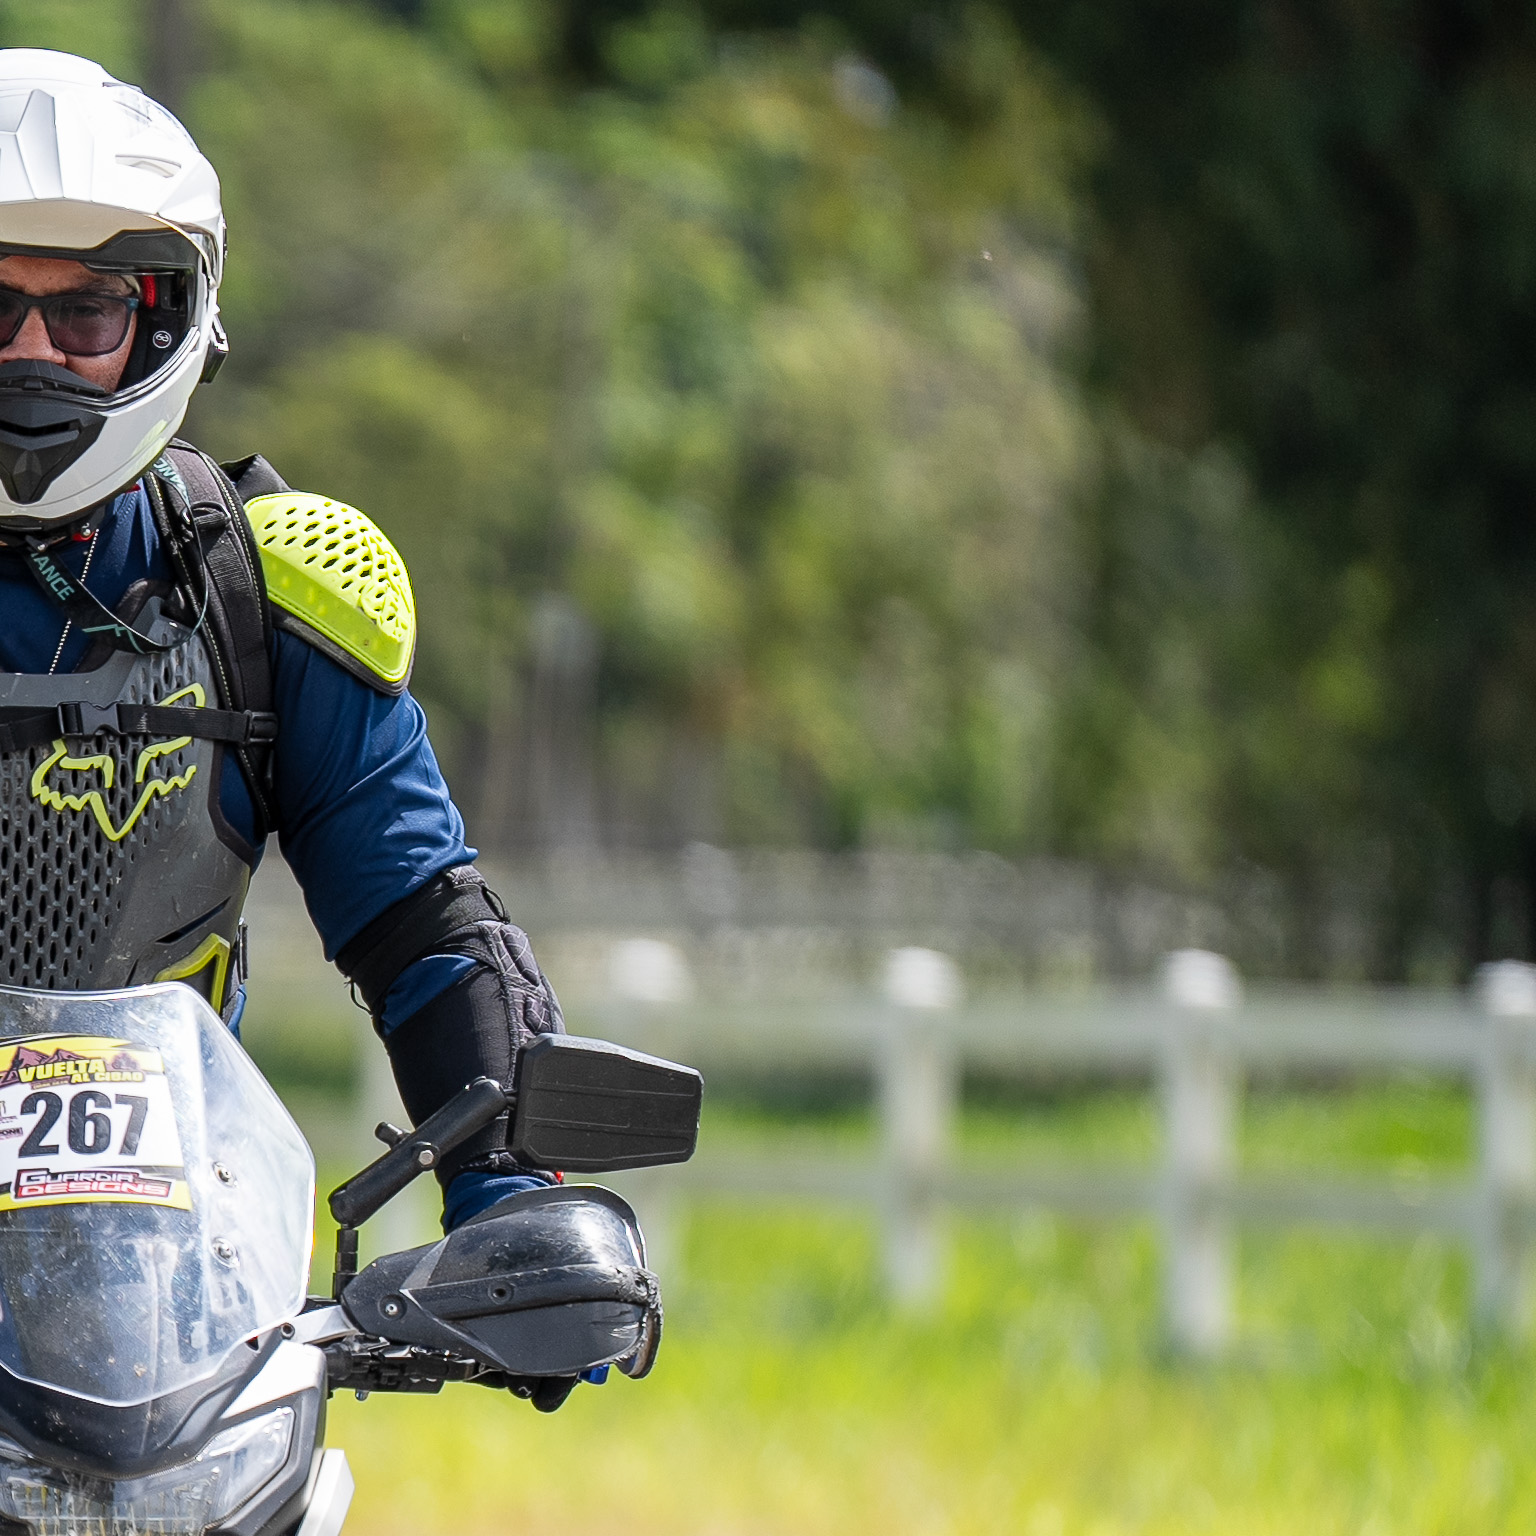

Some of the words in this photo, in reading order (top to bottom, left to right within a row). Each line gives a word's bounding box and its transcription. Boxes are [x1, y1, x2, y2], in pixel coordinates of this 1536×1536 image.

[18, 1059, 107, 1083] VUELTA
[70, 1072, 92, 1084] AL
[94, 1071, 144, 1082] CIBAO
[18, 1090, 149, 1159] 267
[20, 1181, 168, 1197] DESIGNS
